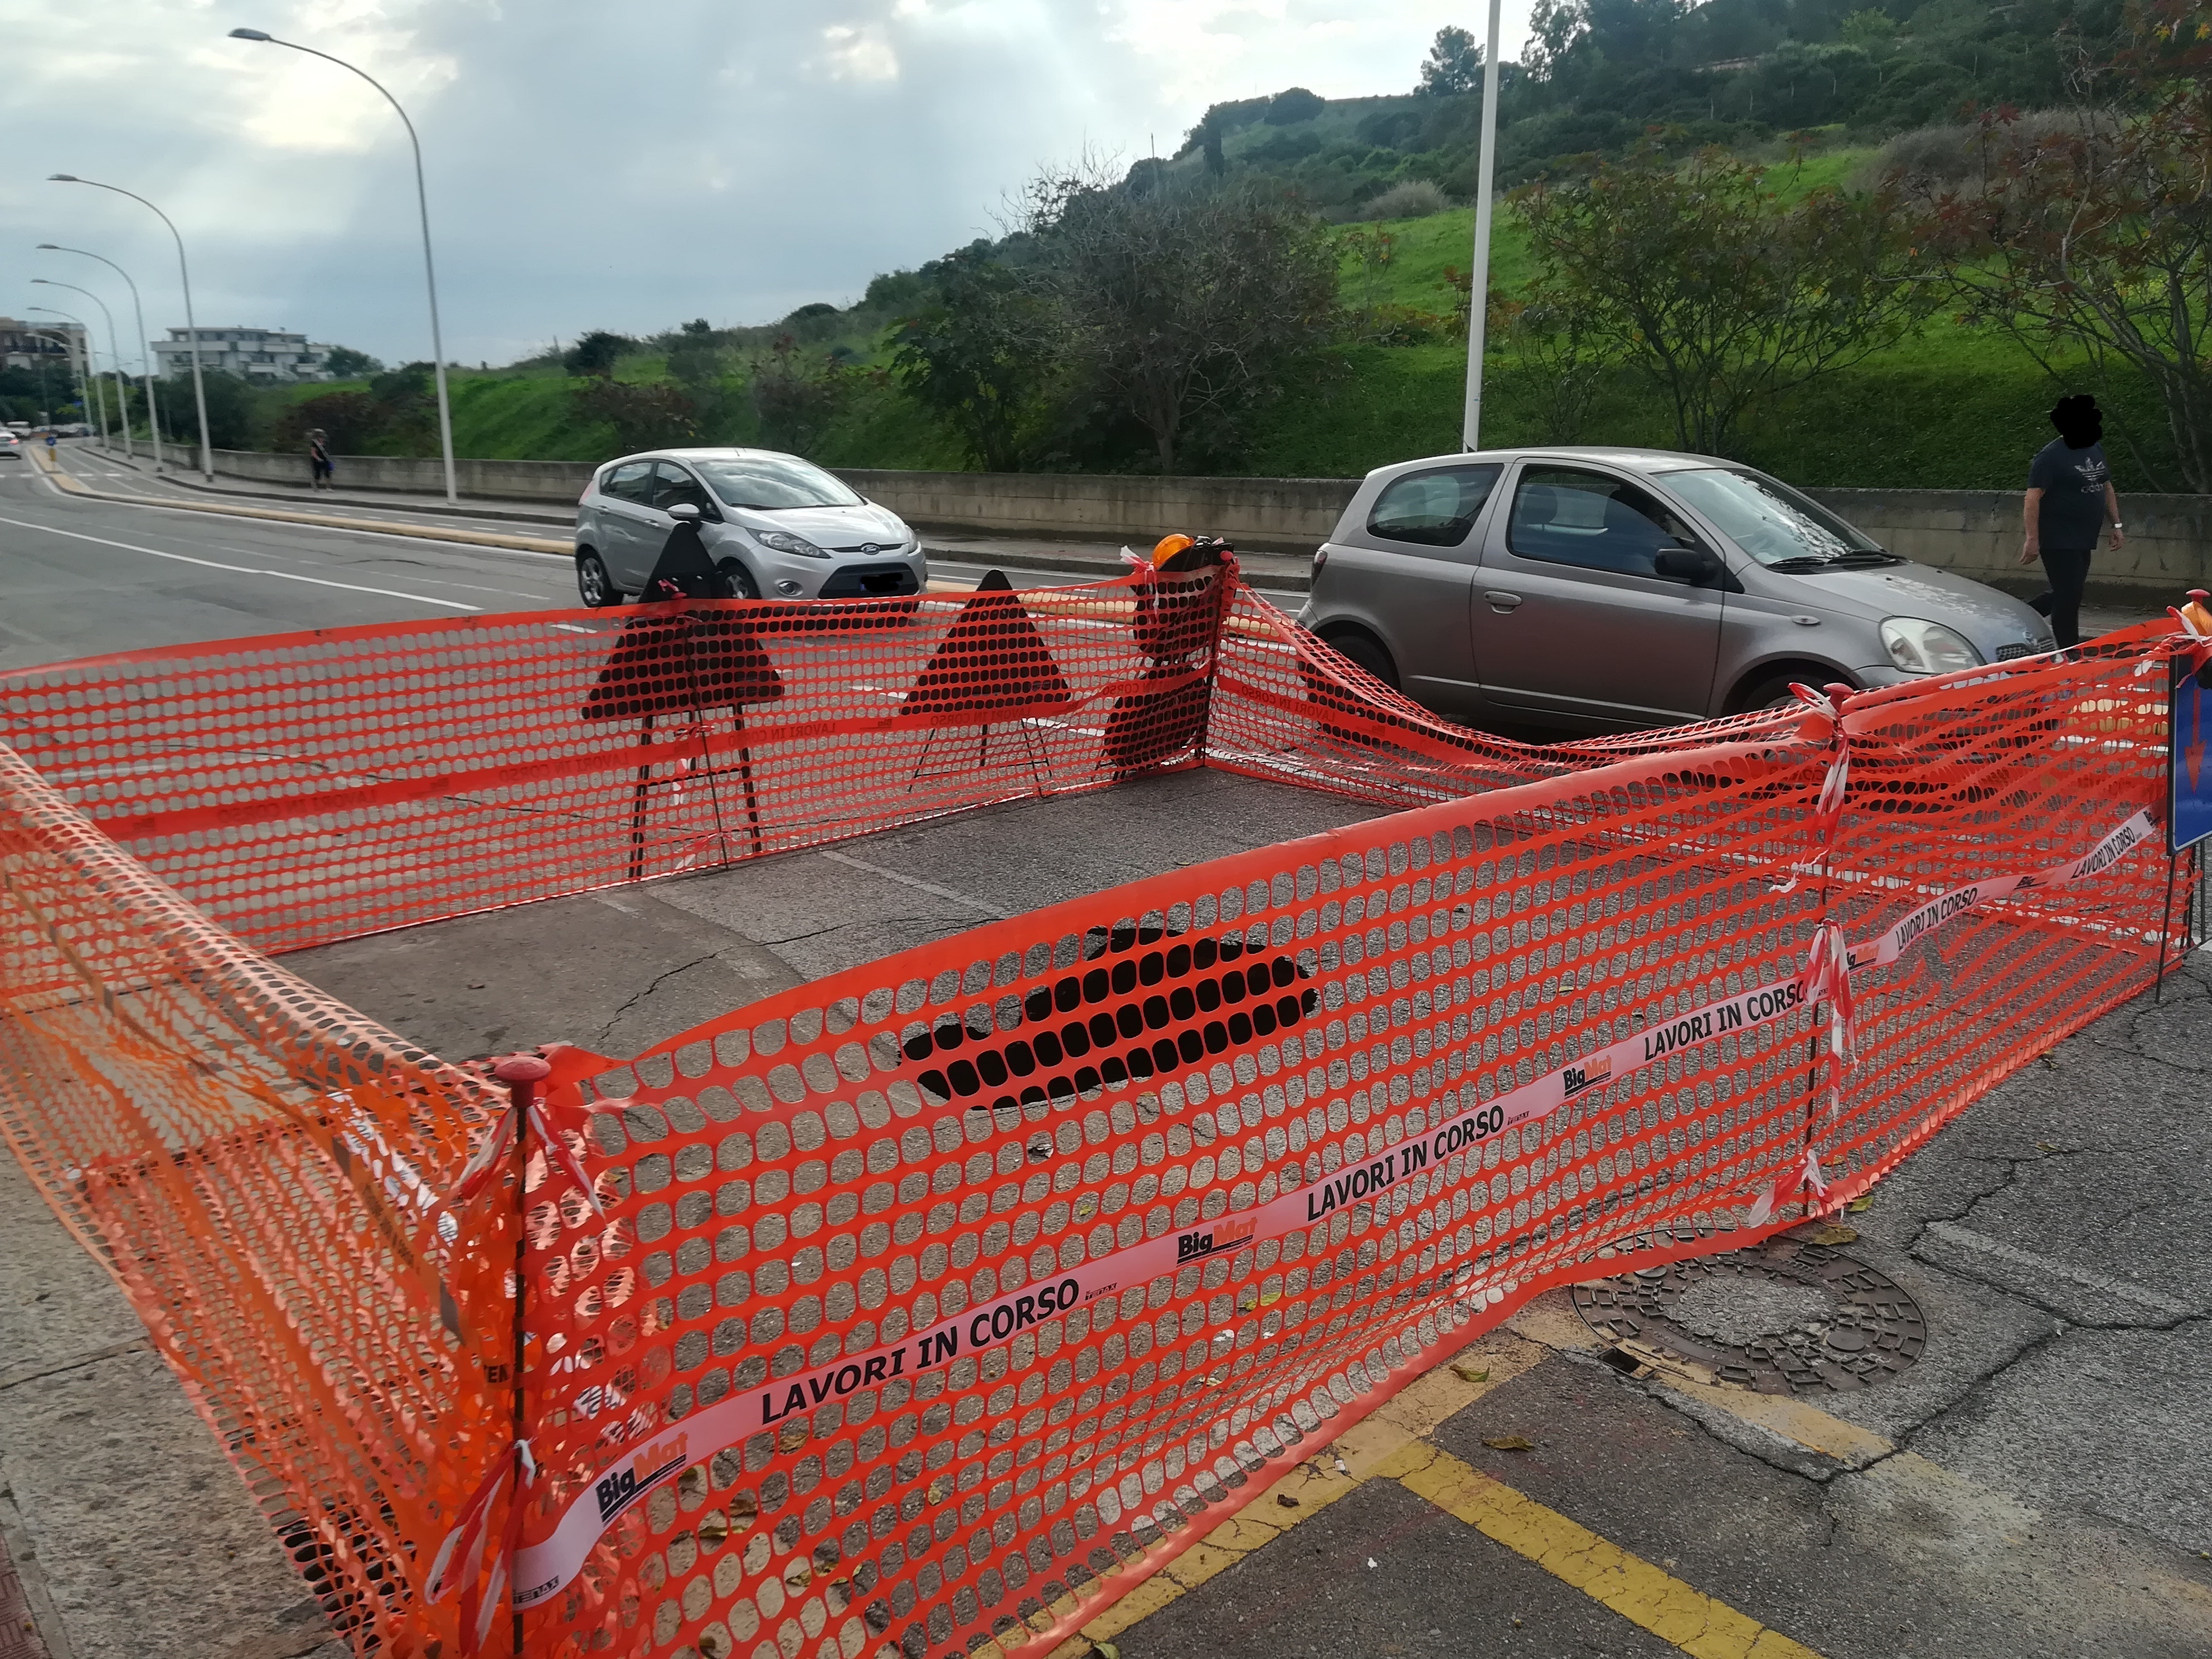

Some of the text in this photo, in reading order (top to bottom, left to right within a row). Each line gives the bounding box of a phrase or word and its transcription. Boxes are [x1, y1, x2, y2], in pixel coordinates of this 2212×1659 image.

[2070, 826, 2136, 879] LAVORI IN CORSO
[1896, 887, 1977, 950] LAVORI IN CORSO
[1847, 944, 1880, 968] igMat
[1645, 1012, 1712, 1061] LAVORI
[1718, 1003, 1742, 1031] IN
[1563, 1055, 1612, 1090] BigMat
[1307, 1105, 1504, 1222] LAVORI IN CORSO
[1178, 1216, 1258, 1258] BigMat
[761, 1278, 1080, 1425] LAVORI IN CORSO
[595, 1430, 688, 1514] BigMat
